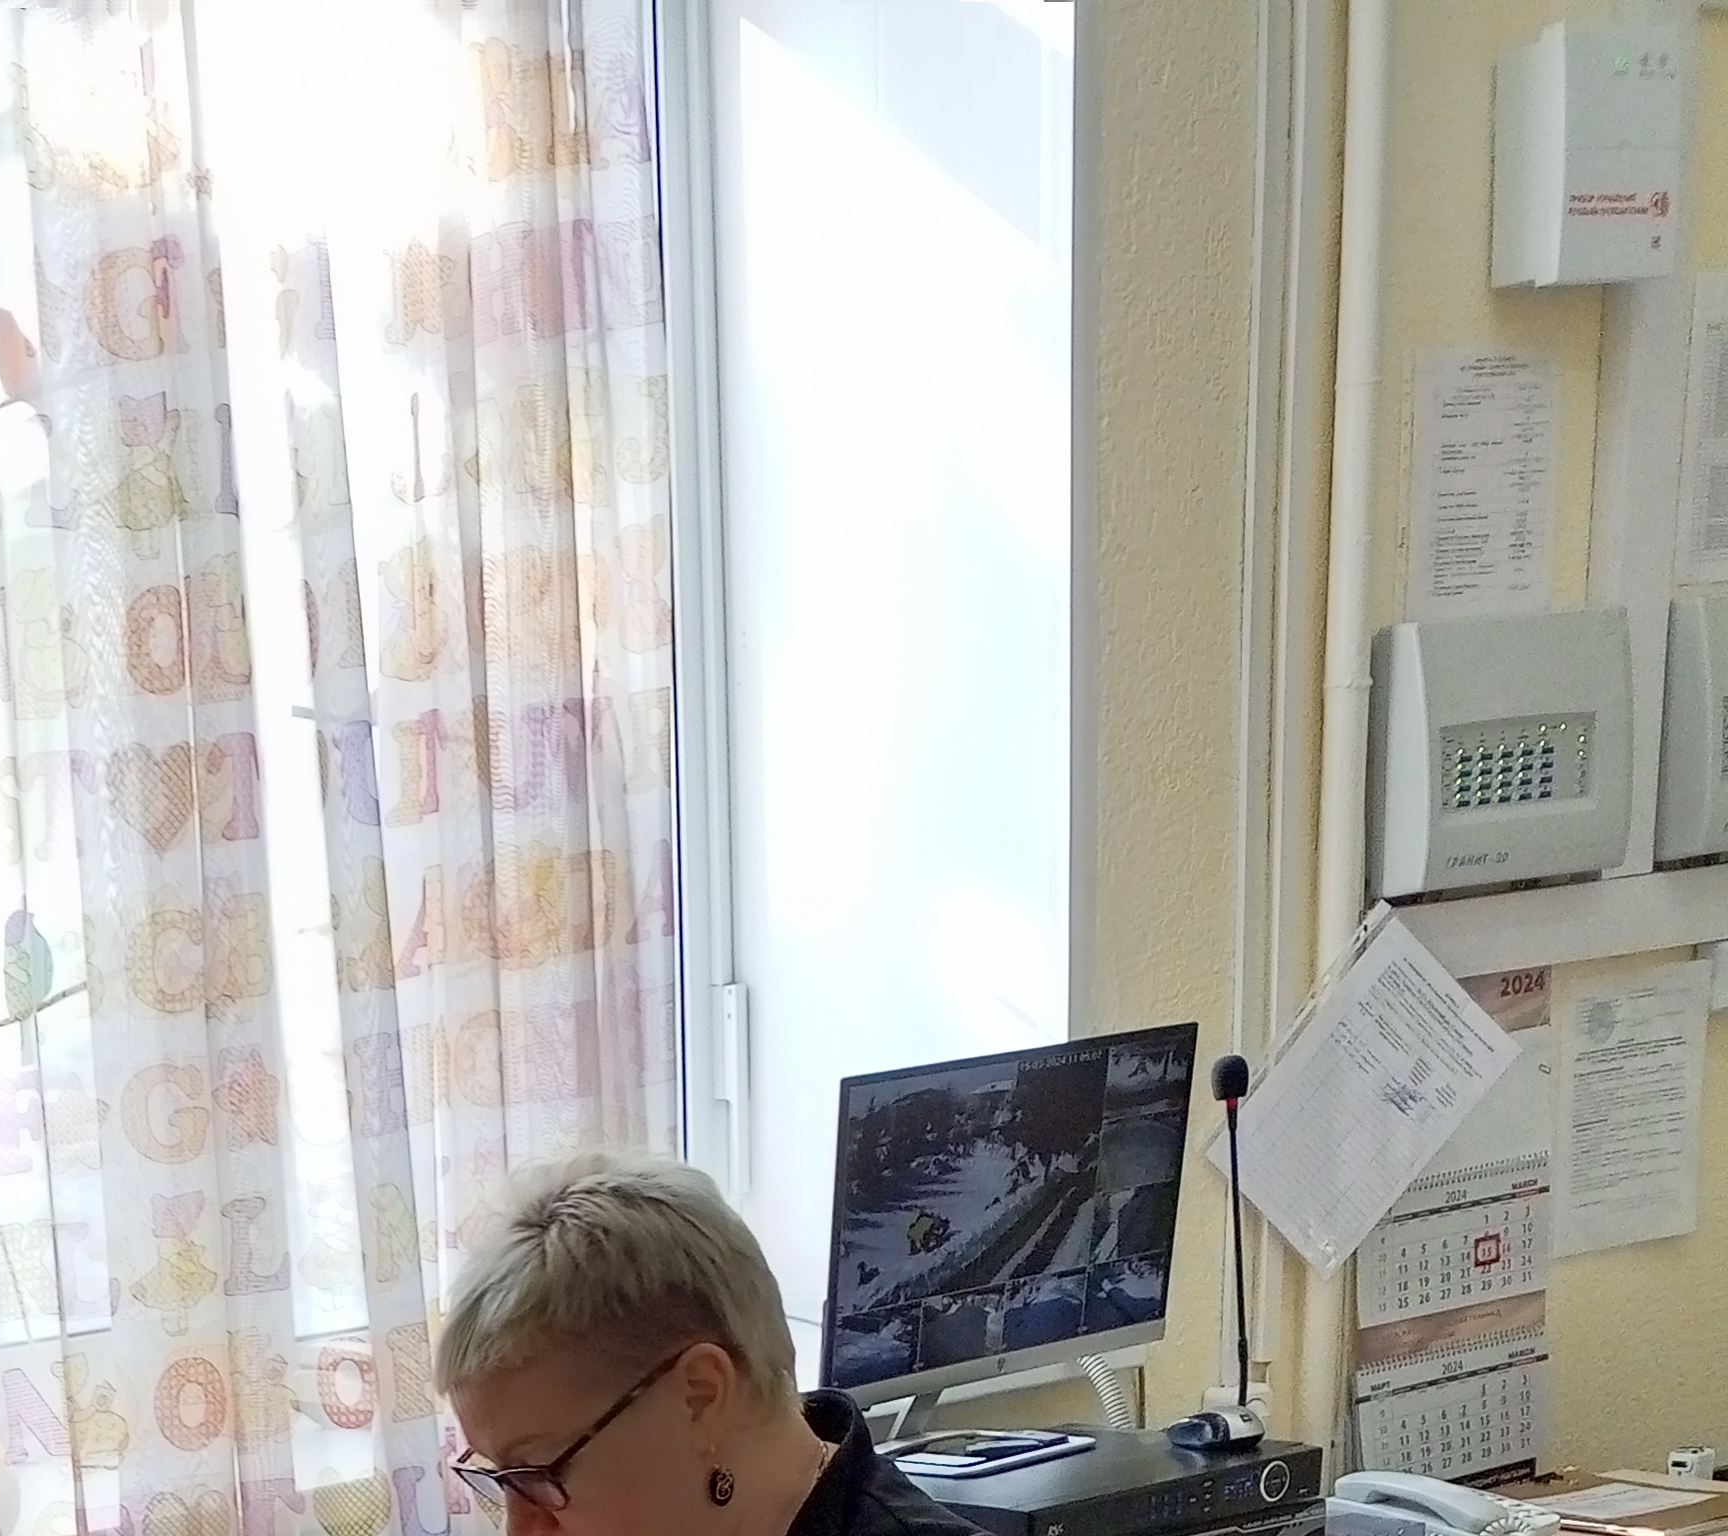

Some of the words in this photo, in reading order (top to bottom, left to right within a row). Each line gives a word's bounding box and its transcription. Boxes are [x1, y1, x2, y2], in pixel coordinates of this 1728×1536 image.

[1499, 970, 1546, 997] 2024
[1445, 1190, 1467, 1203] 2024
[1442, 1361, 1464, 1374] 2024
